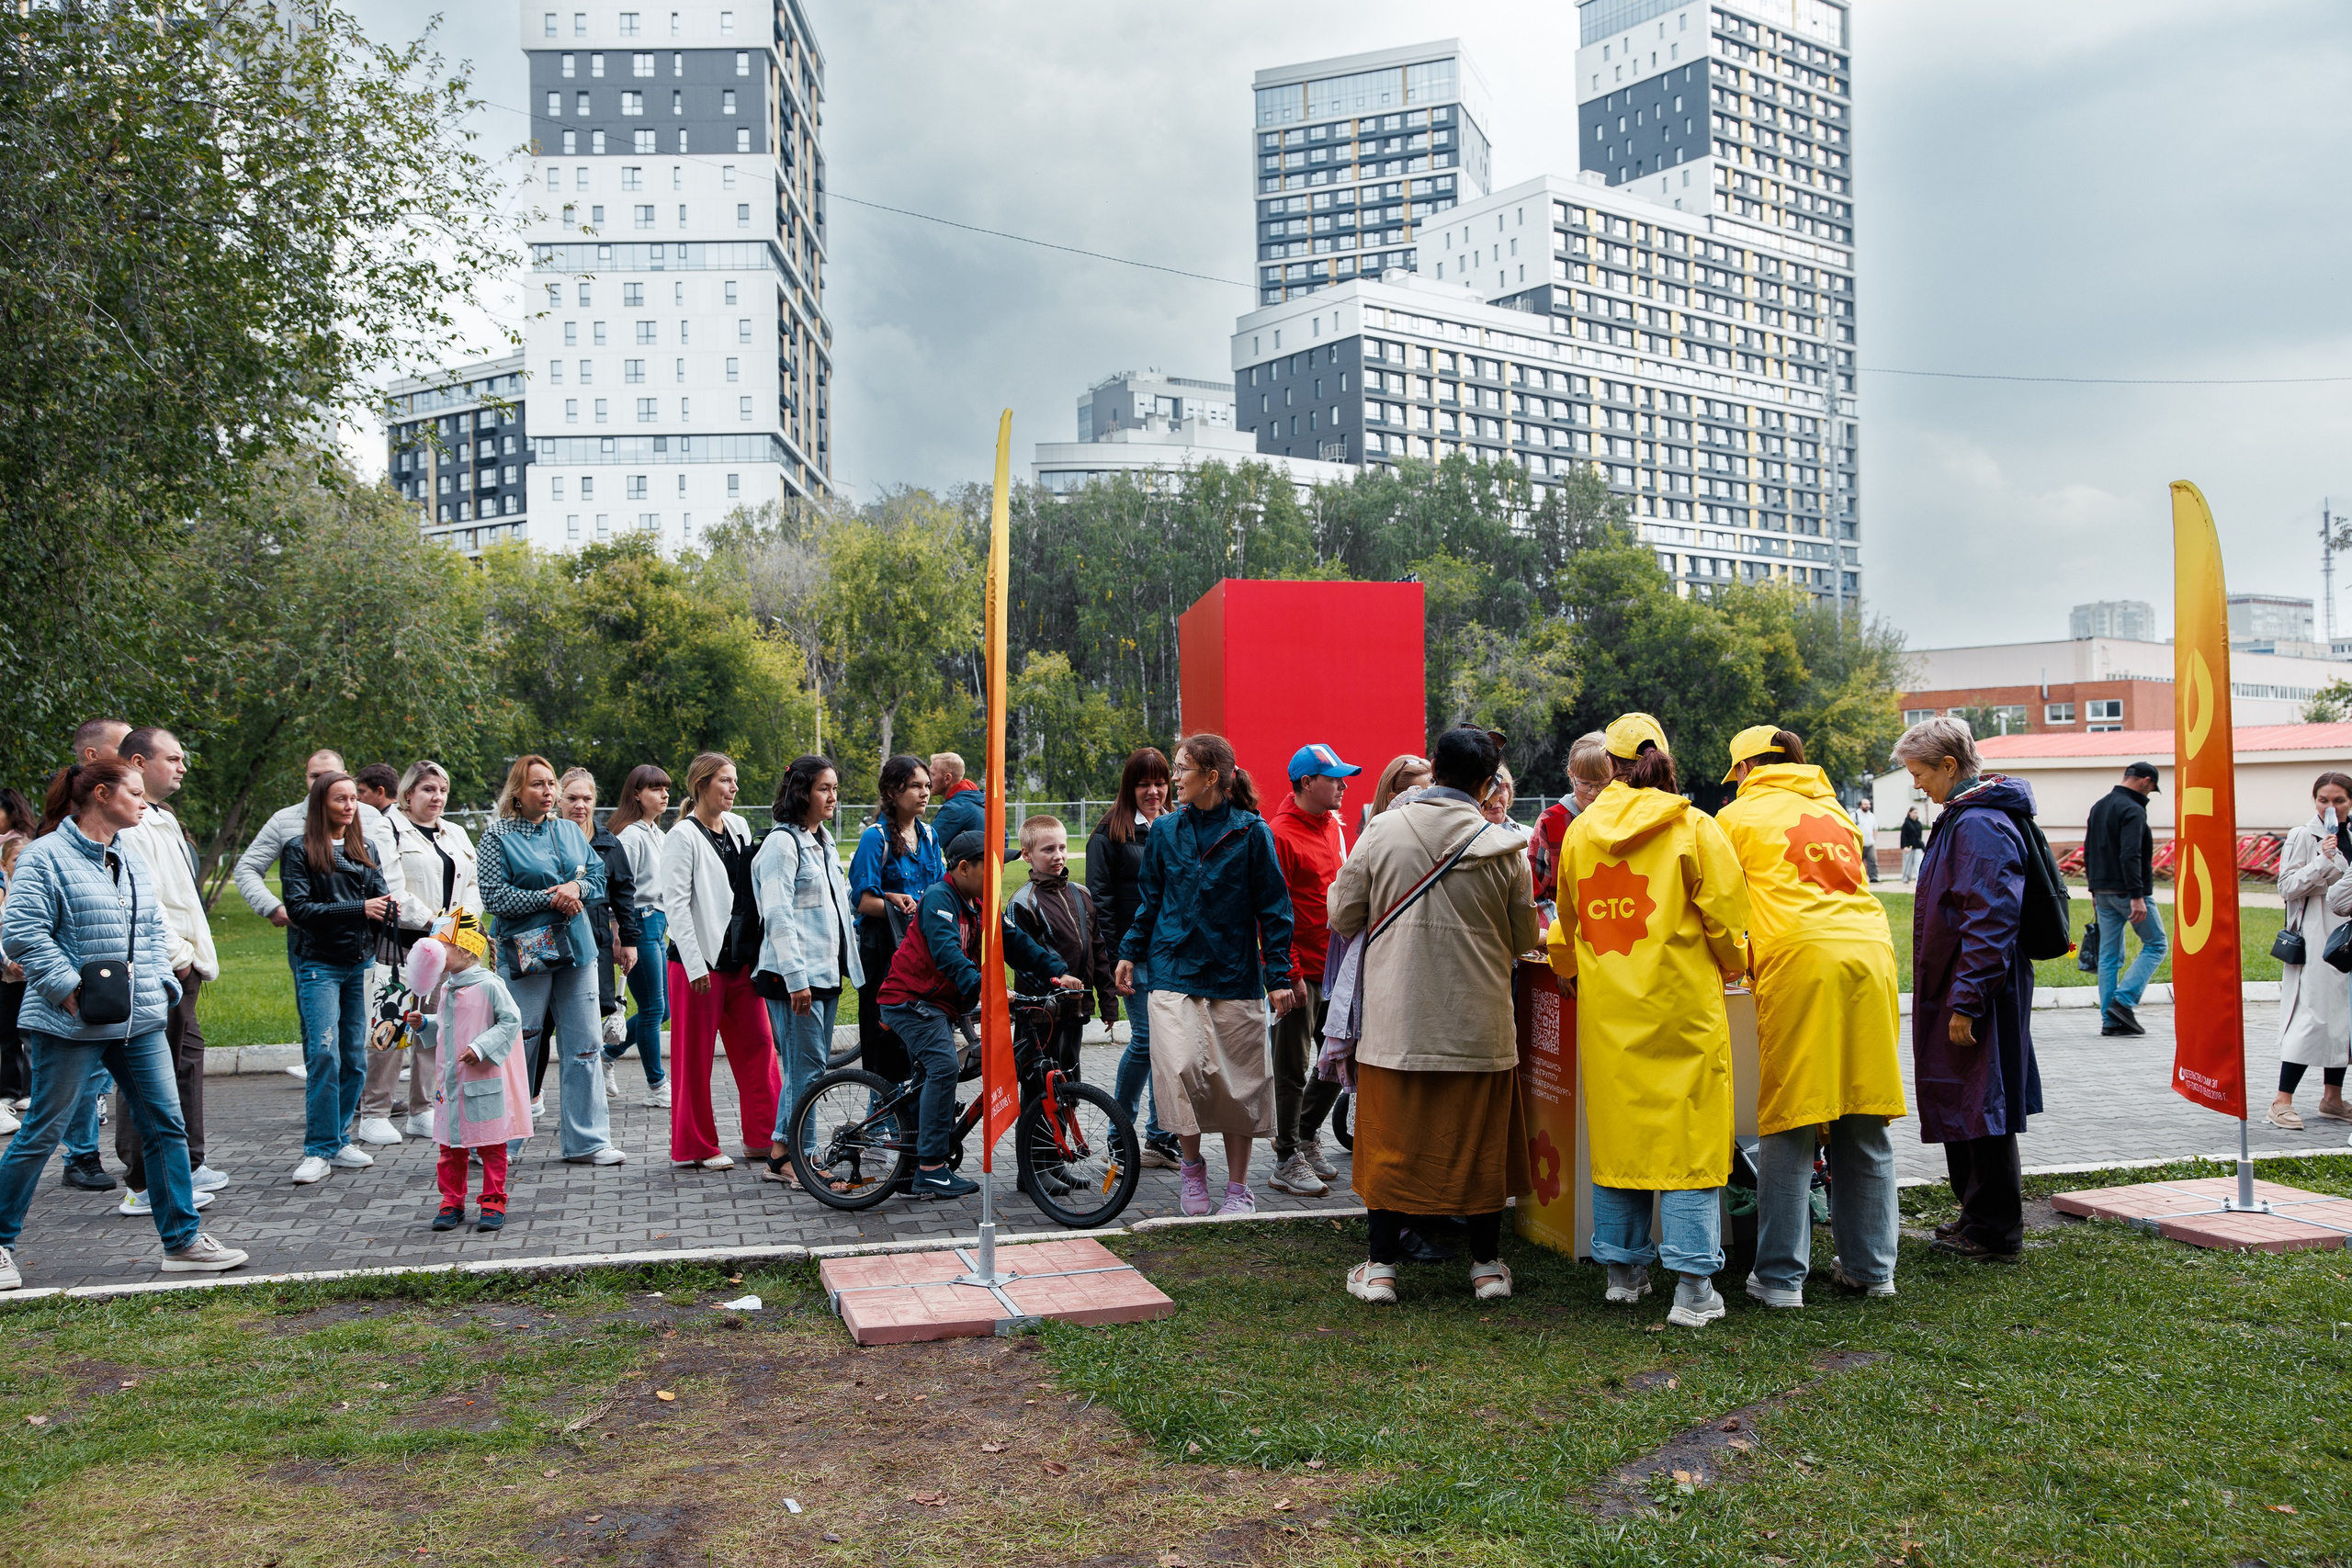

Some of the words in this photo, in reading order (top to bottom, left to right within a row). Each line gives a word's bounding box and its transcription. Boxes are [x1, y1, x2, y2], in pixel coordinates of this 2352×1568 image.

[2177, 648, 2214, 955] СТС
[1804, 842, 1851, 863] СТС
[1588, 897, 1635, 920] СТС
[1529, 1055, 1562, 1073] ПОДПИШИСЬ
[1532, 1066, 1539, 1075] НА
[1539, 1068, 1559, 1082] ГРУППУ
[1531, 1087, 1559, 1104] ВКОНТАКТЕ
[1532, 1076, 1572, 1098] ЕКАТЕРИНБУРГ»
